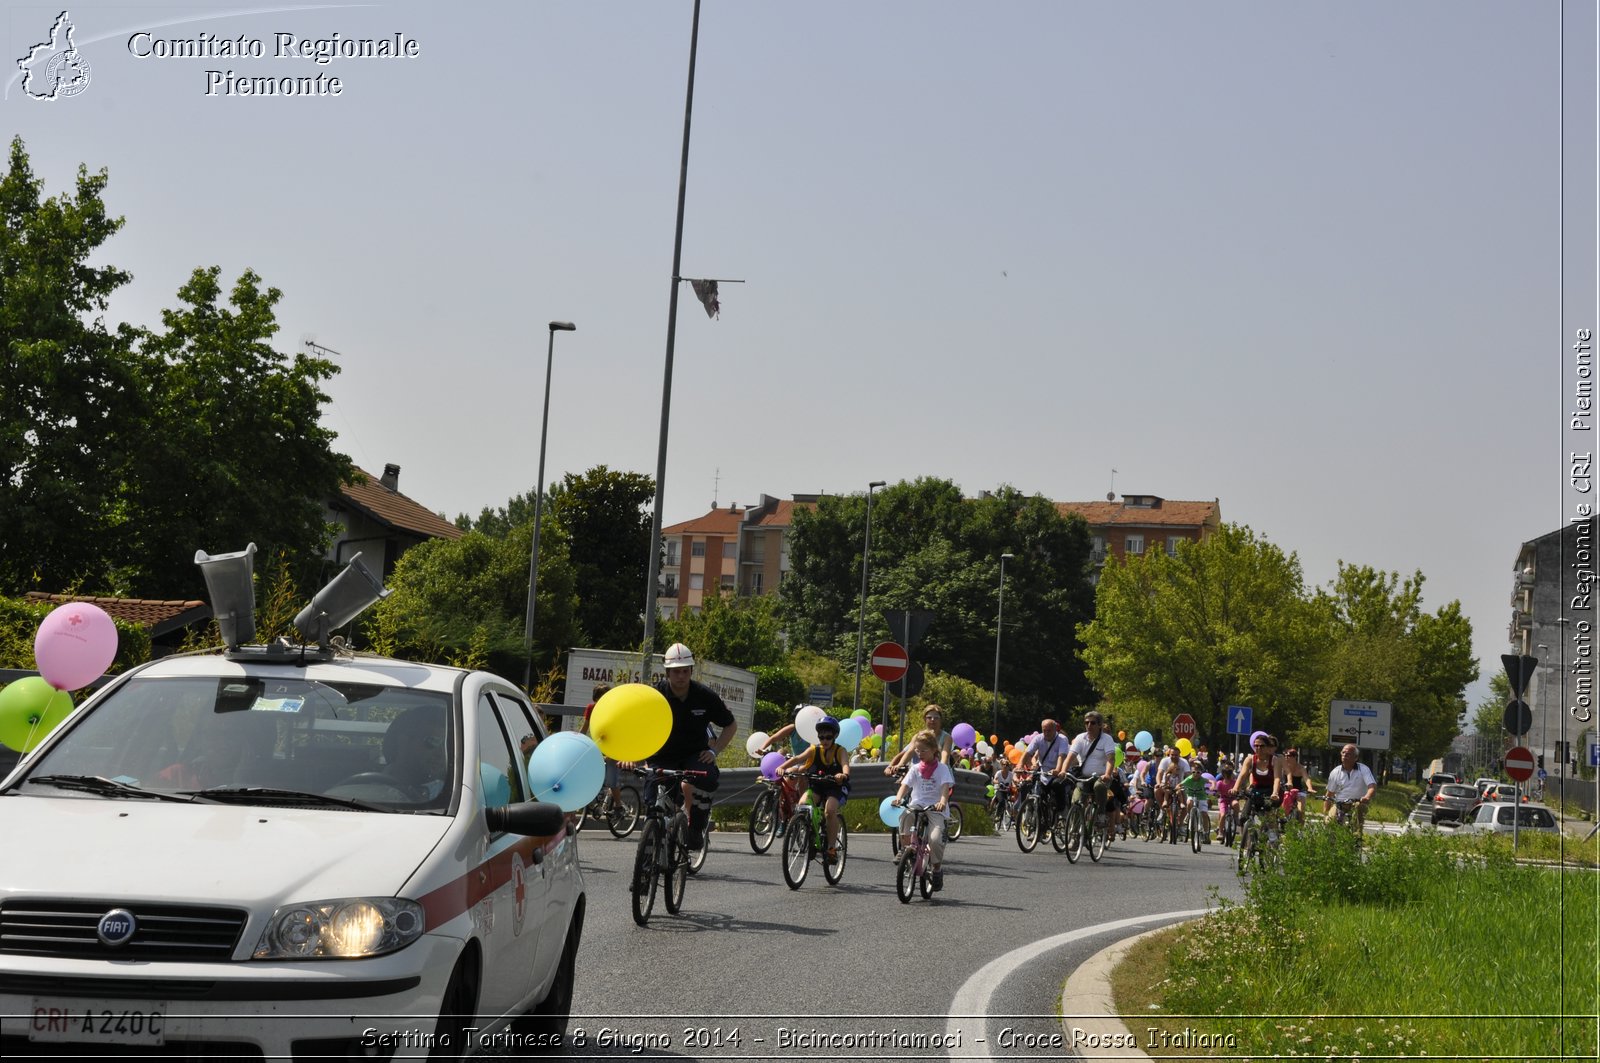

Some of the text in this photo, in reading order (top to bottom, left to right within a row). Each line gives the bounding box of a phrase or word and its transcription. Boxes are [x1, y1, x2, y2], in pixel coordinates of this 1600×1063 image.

[582, 667, 614, 682] BAZAR
[1175, 722, 1194, 733] STOP
[103, 920, 129, 934] FIAT
